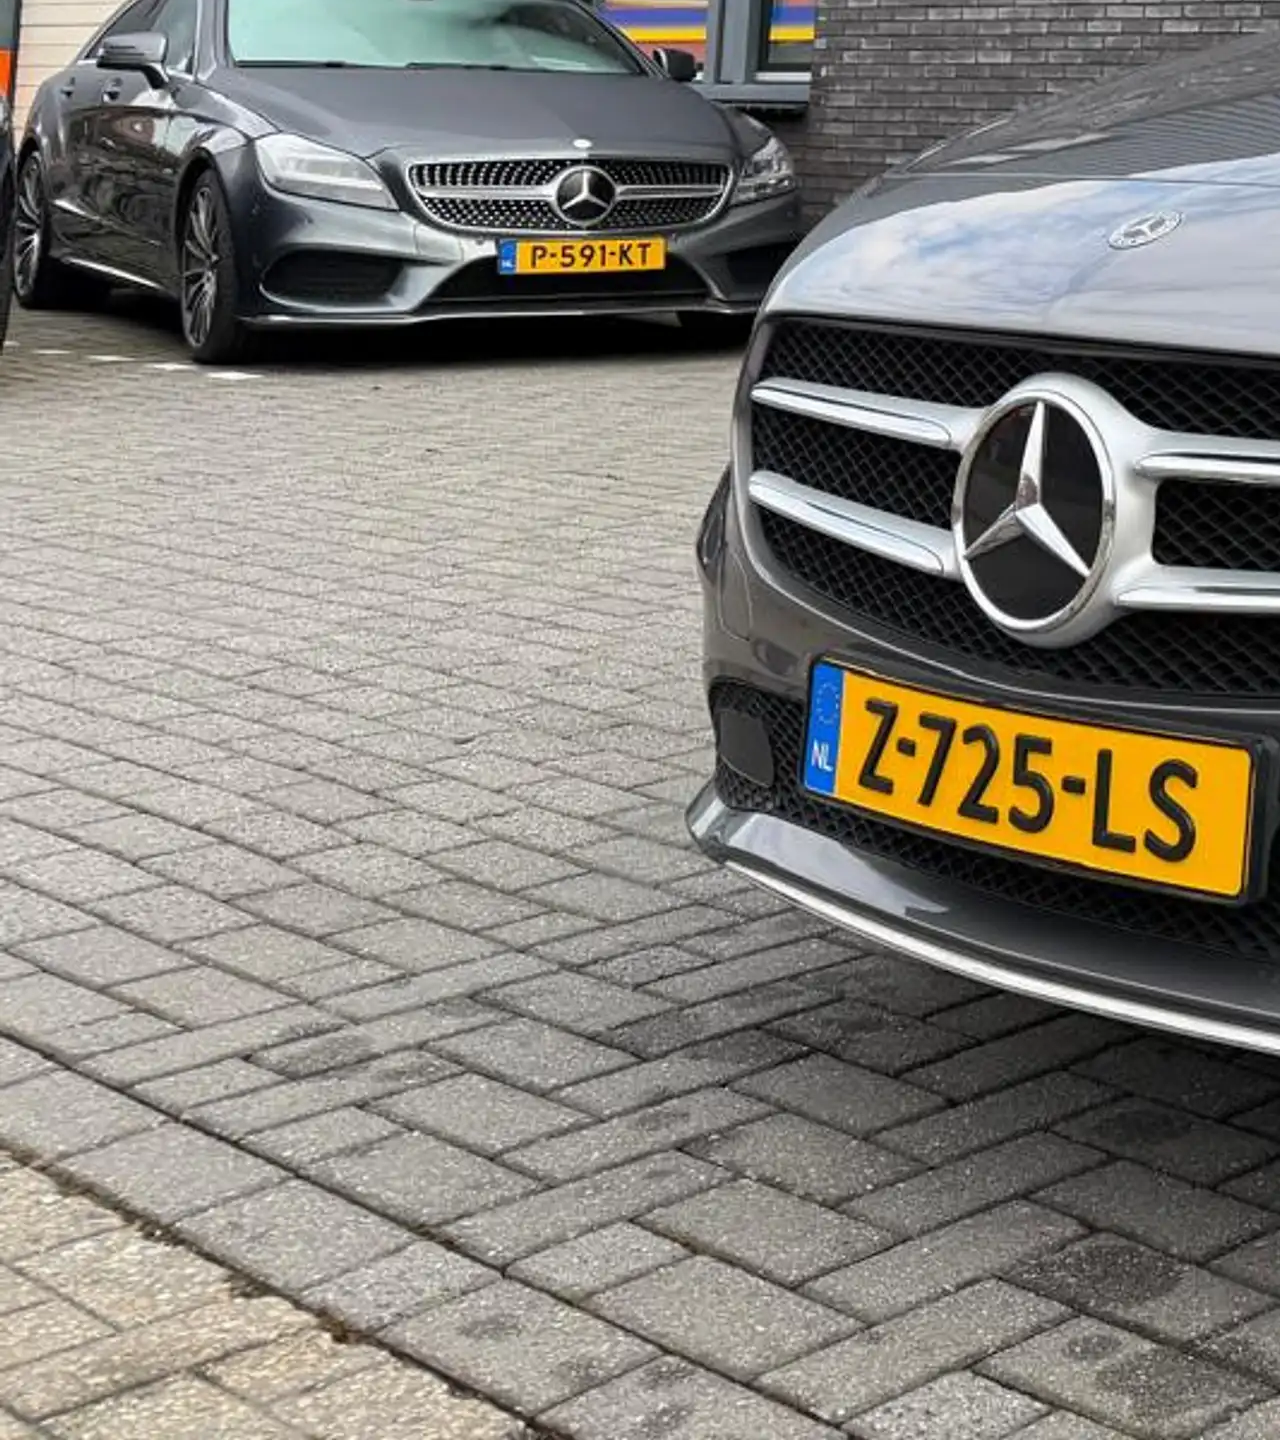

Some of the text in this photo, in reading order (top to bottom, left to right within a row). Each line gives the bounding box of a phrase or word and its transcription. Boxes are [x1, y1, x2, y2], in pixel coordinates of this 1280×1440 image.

[531, 243, 652, 269] P-591-KT
[811, 697, 1198, 862] NL Z-725-LS
